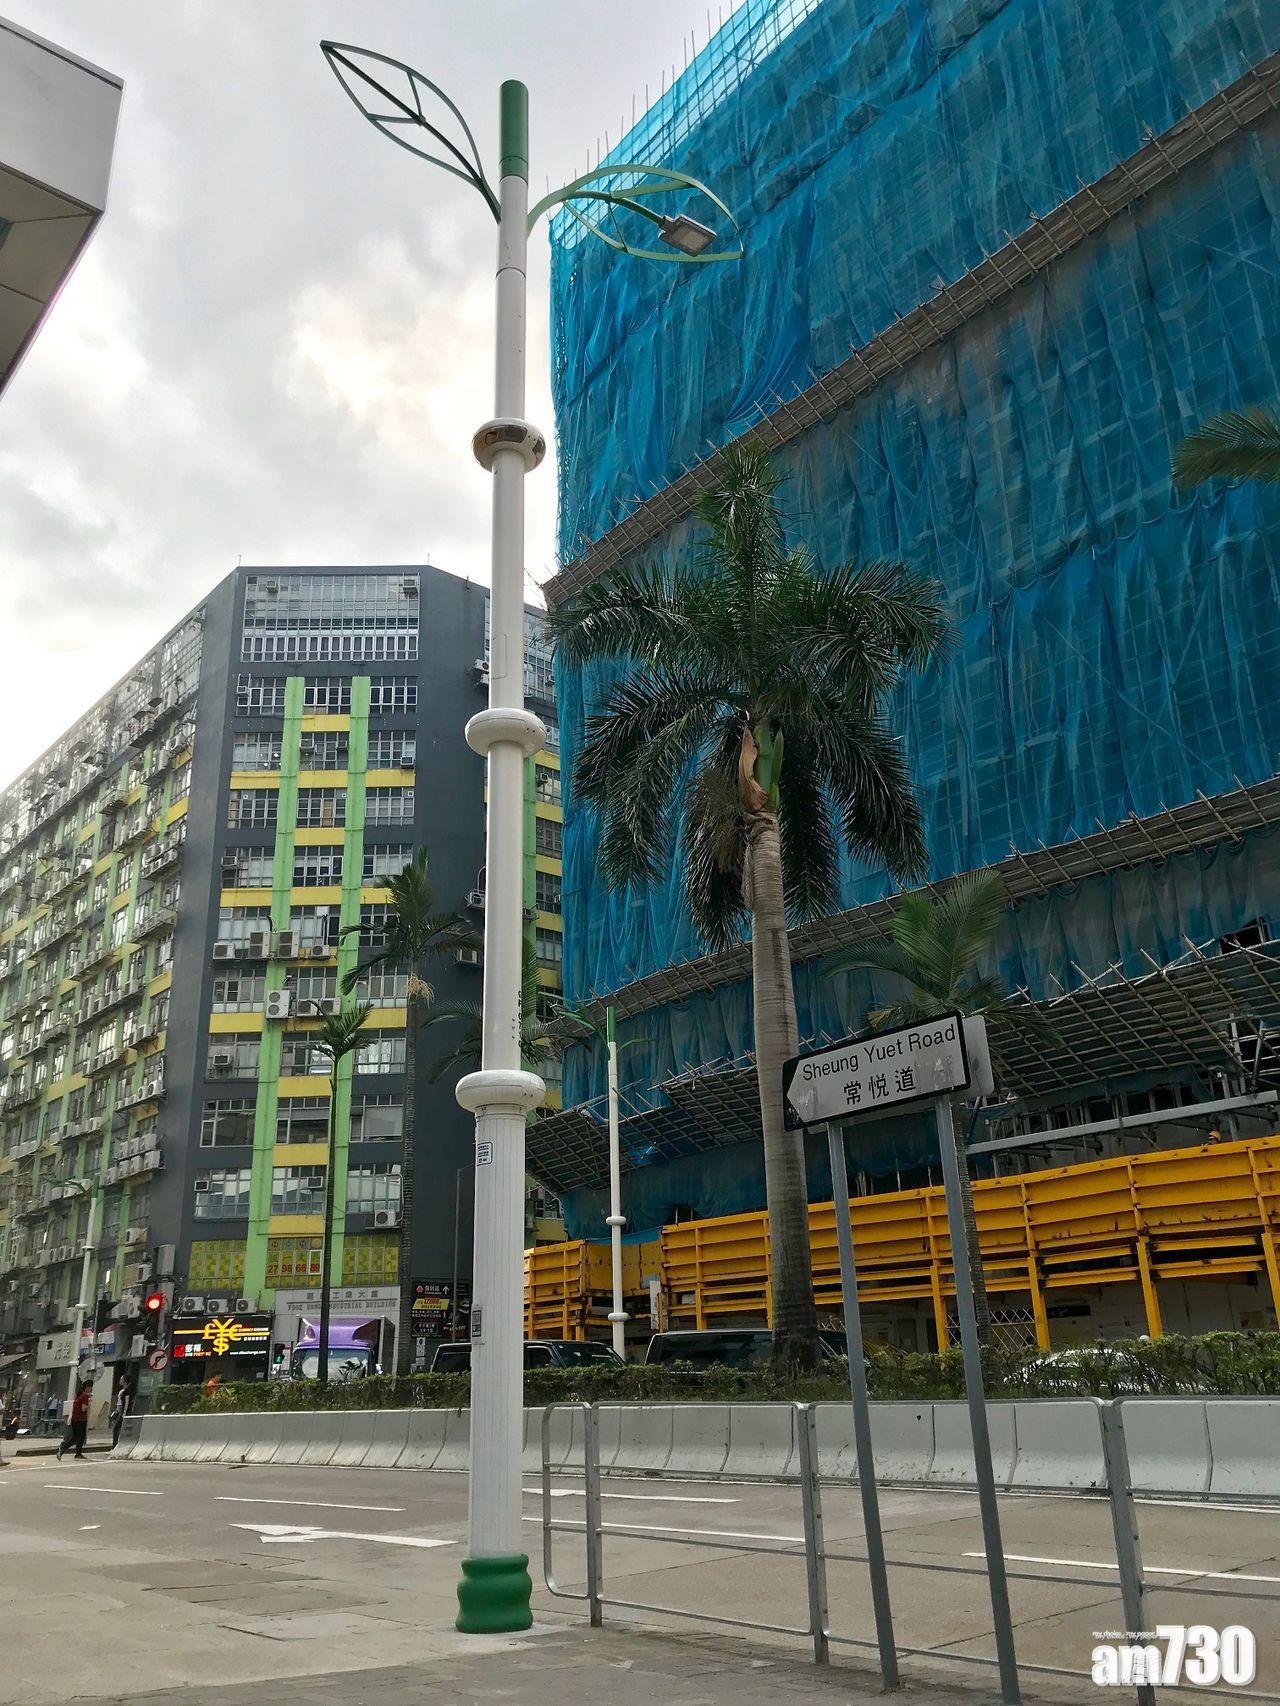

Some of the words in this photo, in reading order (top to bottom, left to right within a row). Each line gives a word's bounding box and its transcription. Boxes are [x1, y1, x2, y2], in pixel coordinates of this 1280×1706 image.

[803, 1055, 859, 1081] Sheung
[864, 1039, 903, 1063] Yuet
[908, 1024, 955, 1052] Road
